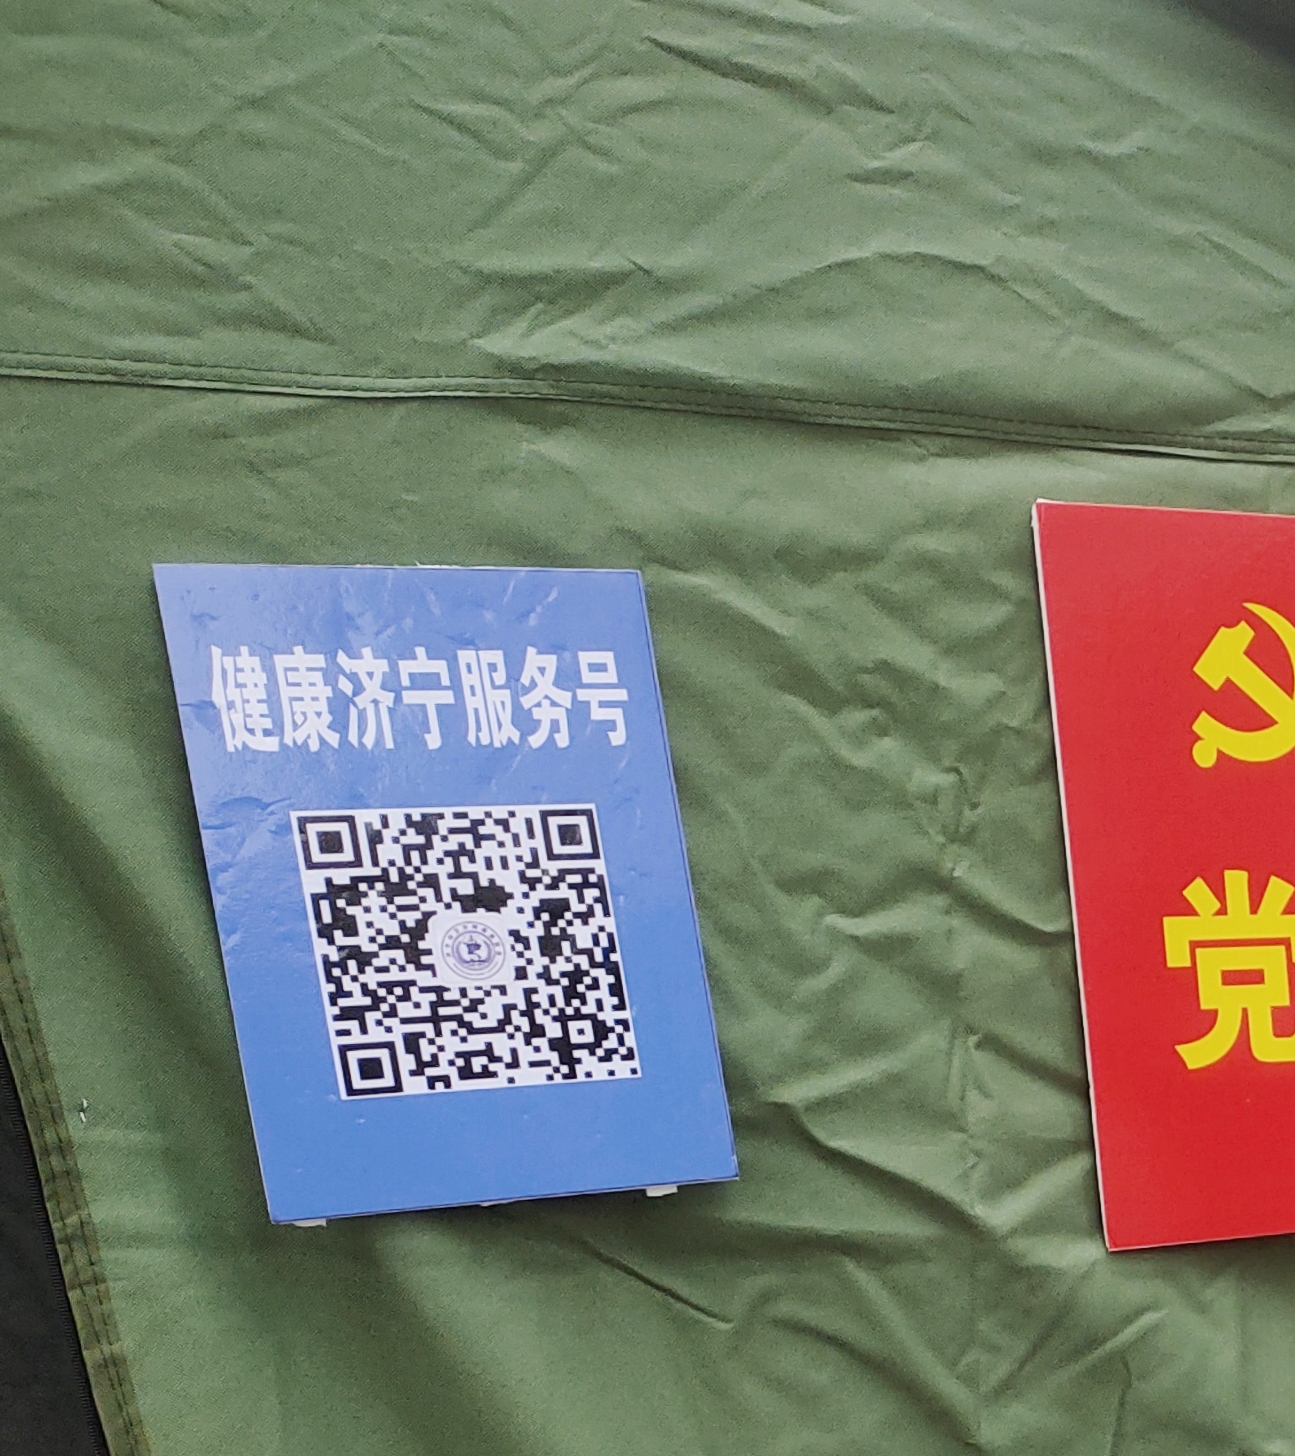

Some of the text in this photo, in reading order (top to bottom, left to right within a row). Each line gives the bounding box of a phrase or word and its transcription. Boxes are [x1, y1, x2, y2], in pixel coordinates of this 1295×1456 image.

[209, 644, 629, 753] 健康济宁服务号
